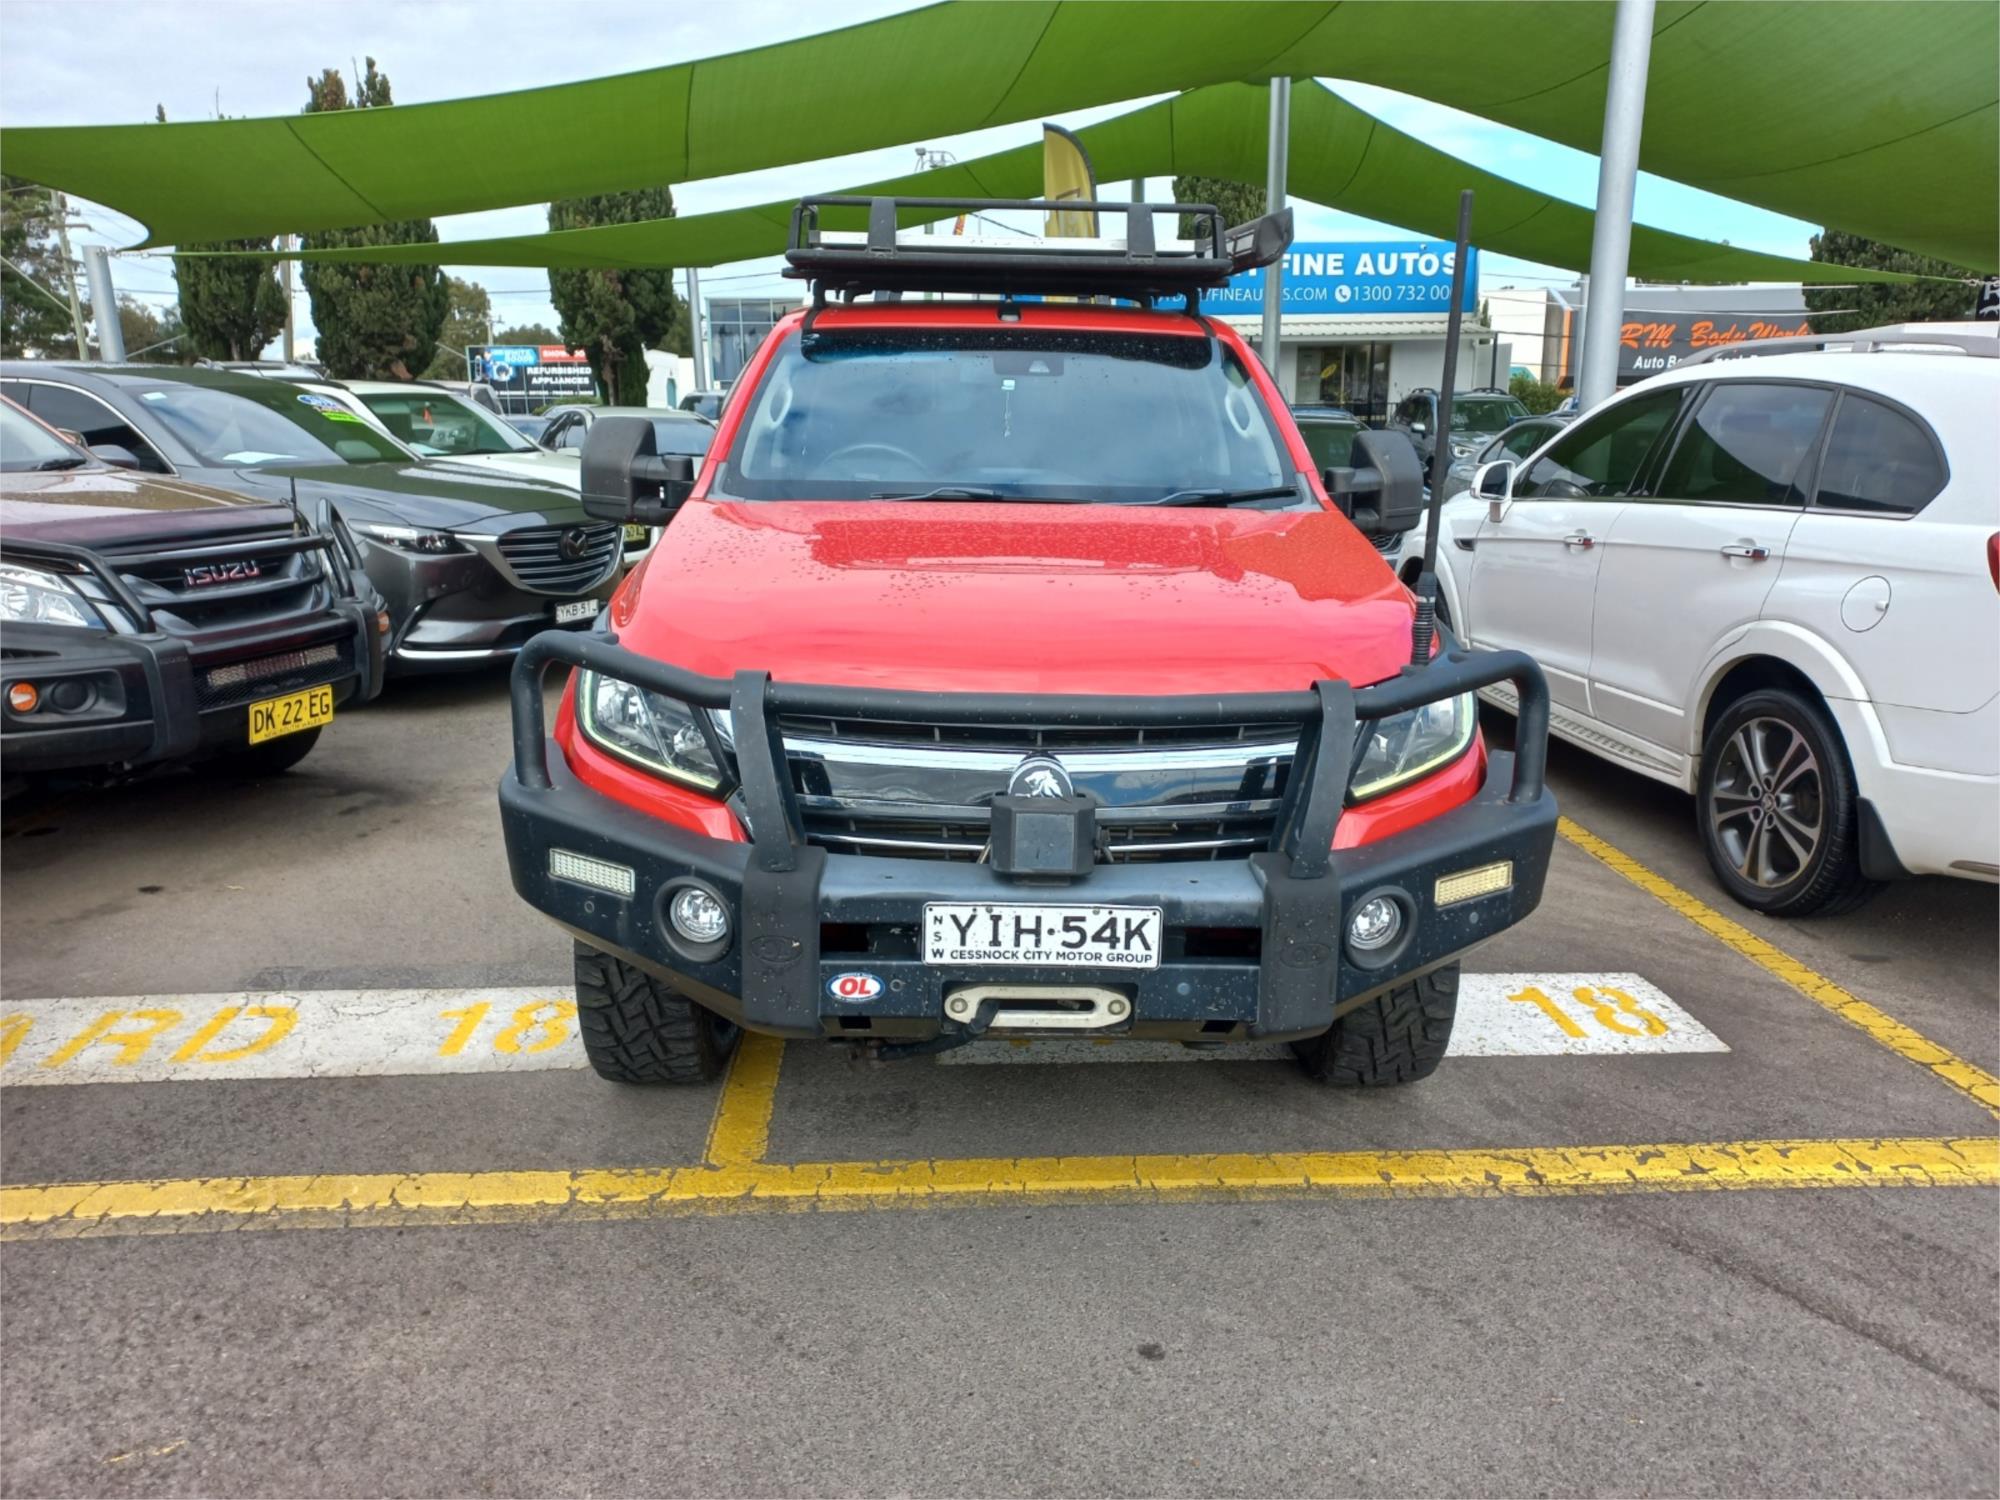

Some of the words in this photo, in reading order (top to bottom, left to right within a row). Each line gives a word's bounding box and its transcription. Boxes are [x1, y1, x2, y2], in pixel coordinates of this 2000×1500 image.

[1354, 252, 1457, 277] AUTOS
[1353, 284, 1393, 301] 1300
[1397, 284, 1426, 301] 732
[1430, 284, 1452, 301] 00
[526, 366, 592, 375] REFURBISHED
[1633, 355, 1665, 370] Auto
[531, 376, 590, 385] APPLIANCES
[184, 560, 261, 586] ISUZU
[949, 948, 1019, 961] CESSNOCK
[1023, 949, 1052, 961] CITY
[1055, 950, 1103, 962] MOTOR
[1106, 951, 1153, 964] GROUP
[839, 976, 871, 997] OL
[1506, 985, 1670, 1039] 18
[437, 1000, 578, 1057] 18
